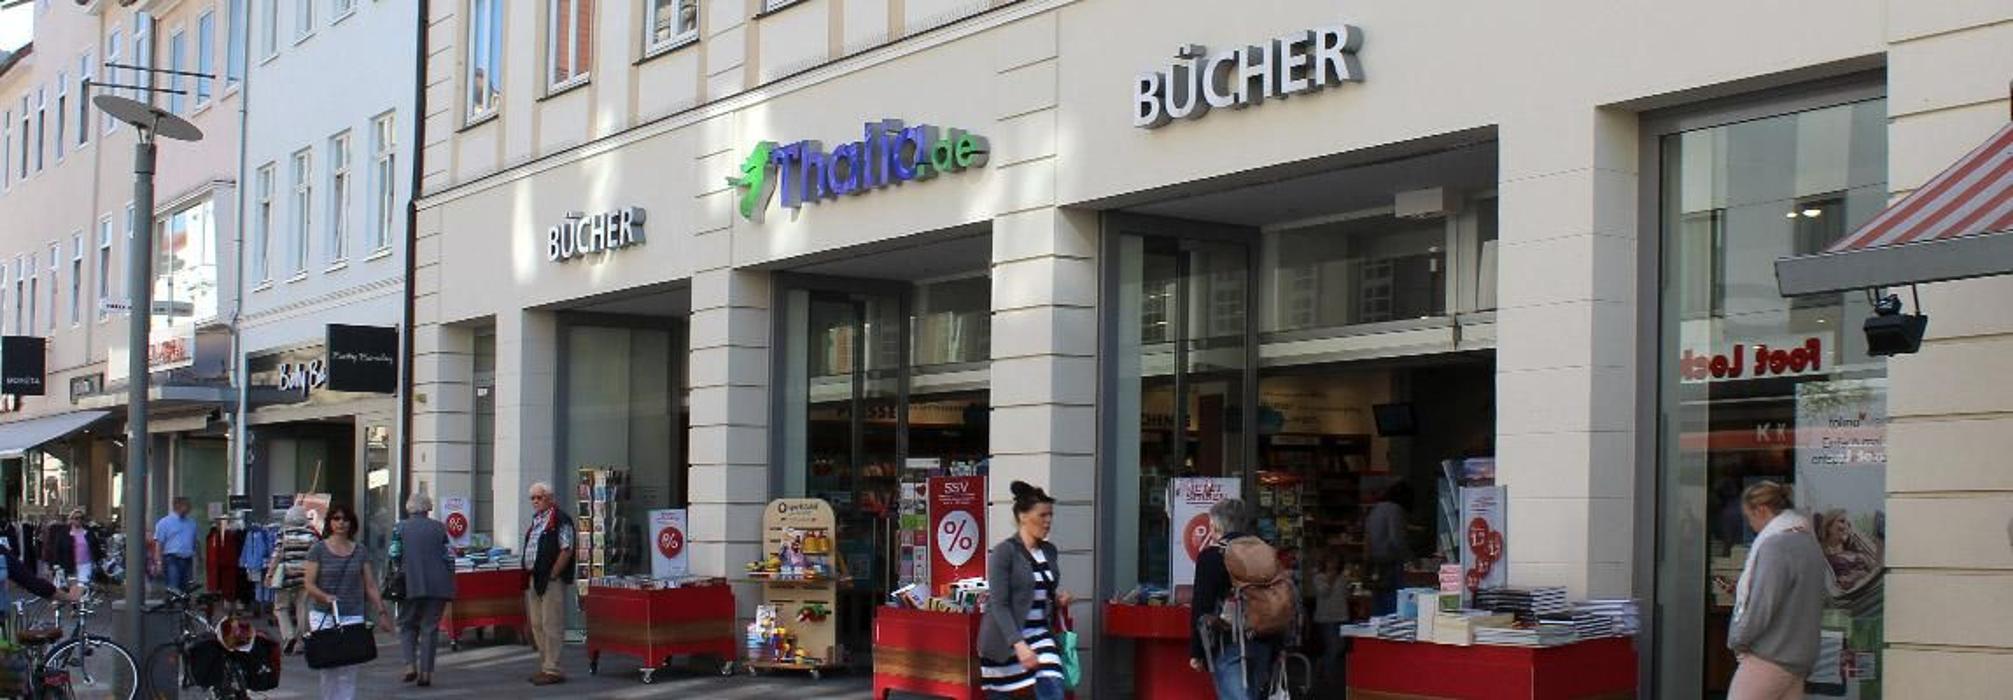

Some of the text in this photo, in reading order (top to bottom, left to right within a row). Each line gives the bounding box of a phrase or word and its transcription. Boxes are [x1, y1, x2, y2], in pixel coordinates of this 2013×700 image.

[1133, 23, 1363, 129] BÜCHER
[771, 118, 988, 208] Thalia.de
[547, 207, 643, 262] BÜCHER
